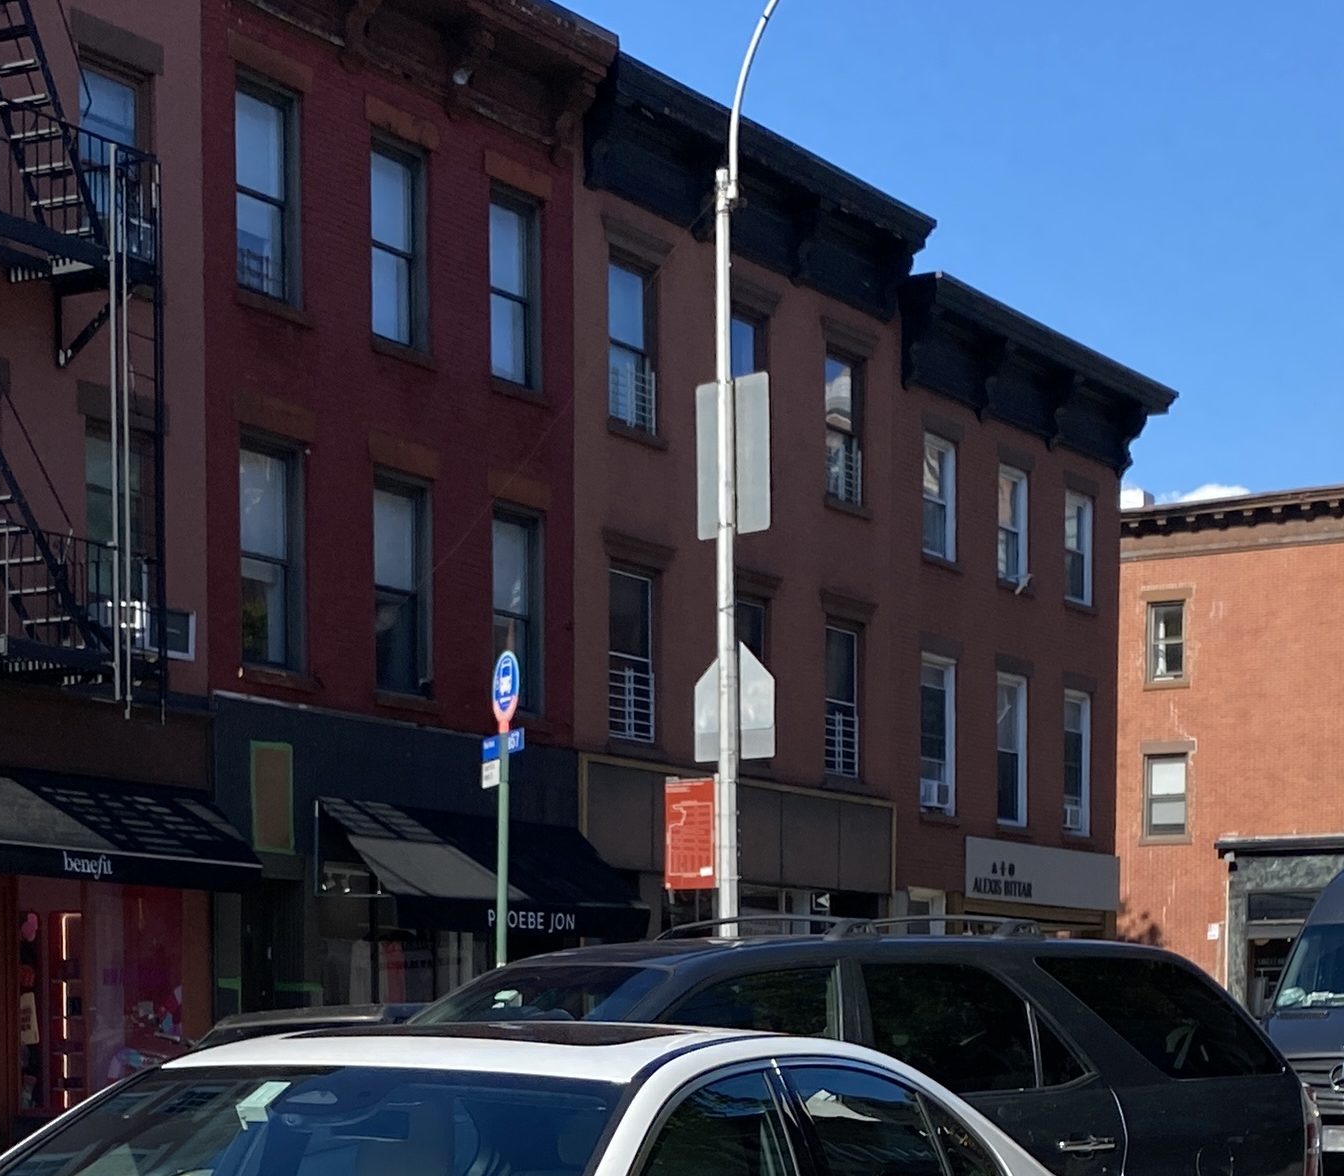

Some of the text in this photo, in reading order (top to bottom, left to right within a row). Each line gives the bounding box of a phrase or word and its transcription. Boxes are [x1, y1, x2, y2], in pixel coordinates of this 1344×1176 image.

[63, 850, 113, 880] benefit
[973, 876, 1033, 899] ALEXIS BITTAR
[488, 908, 575, 933] POEBE JON
